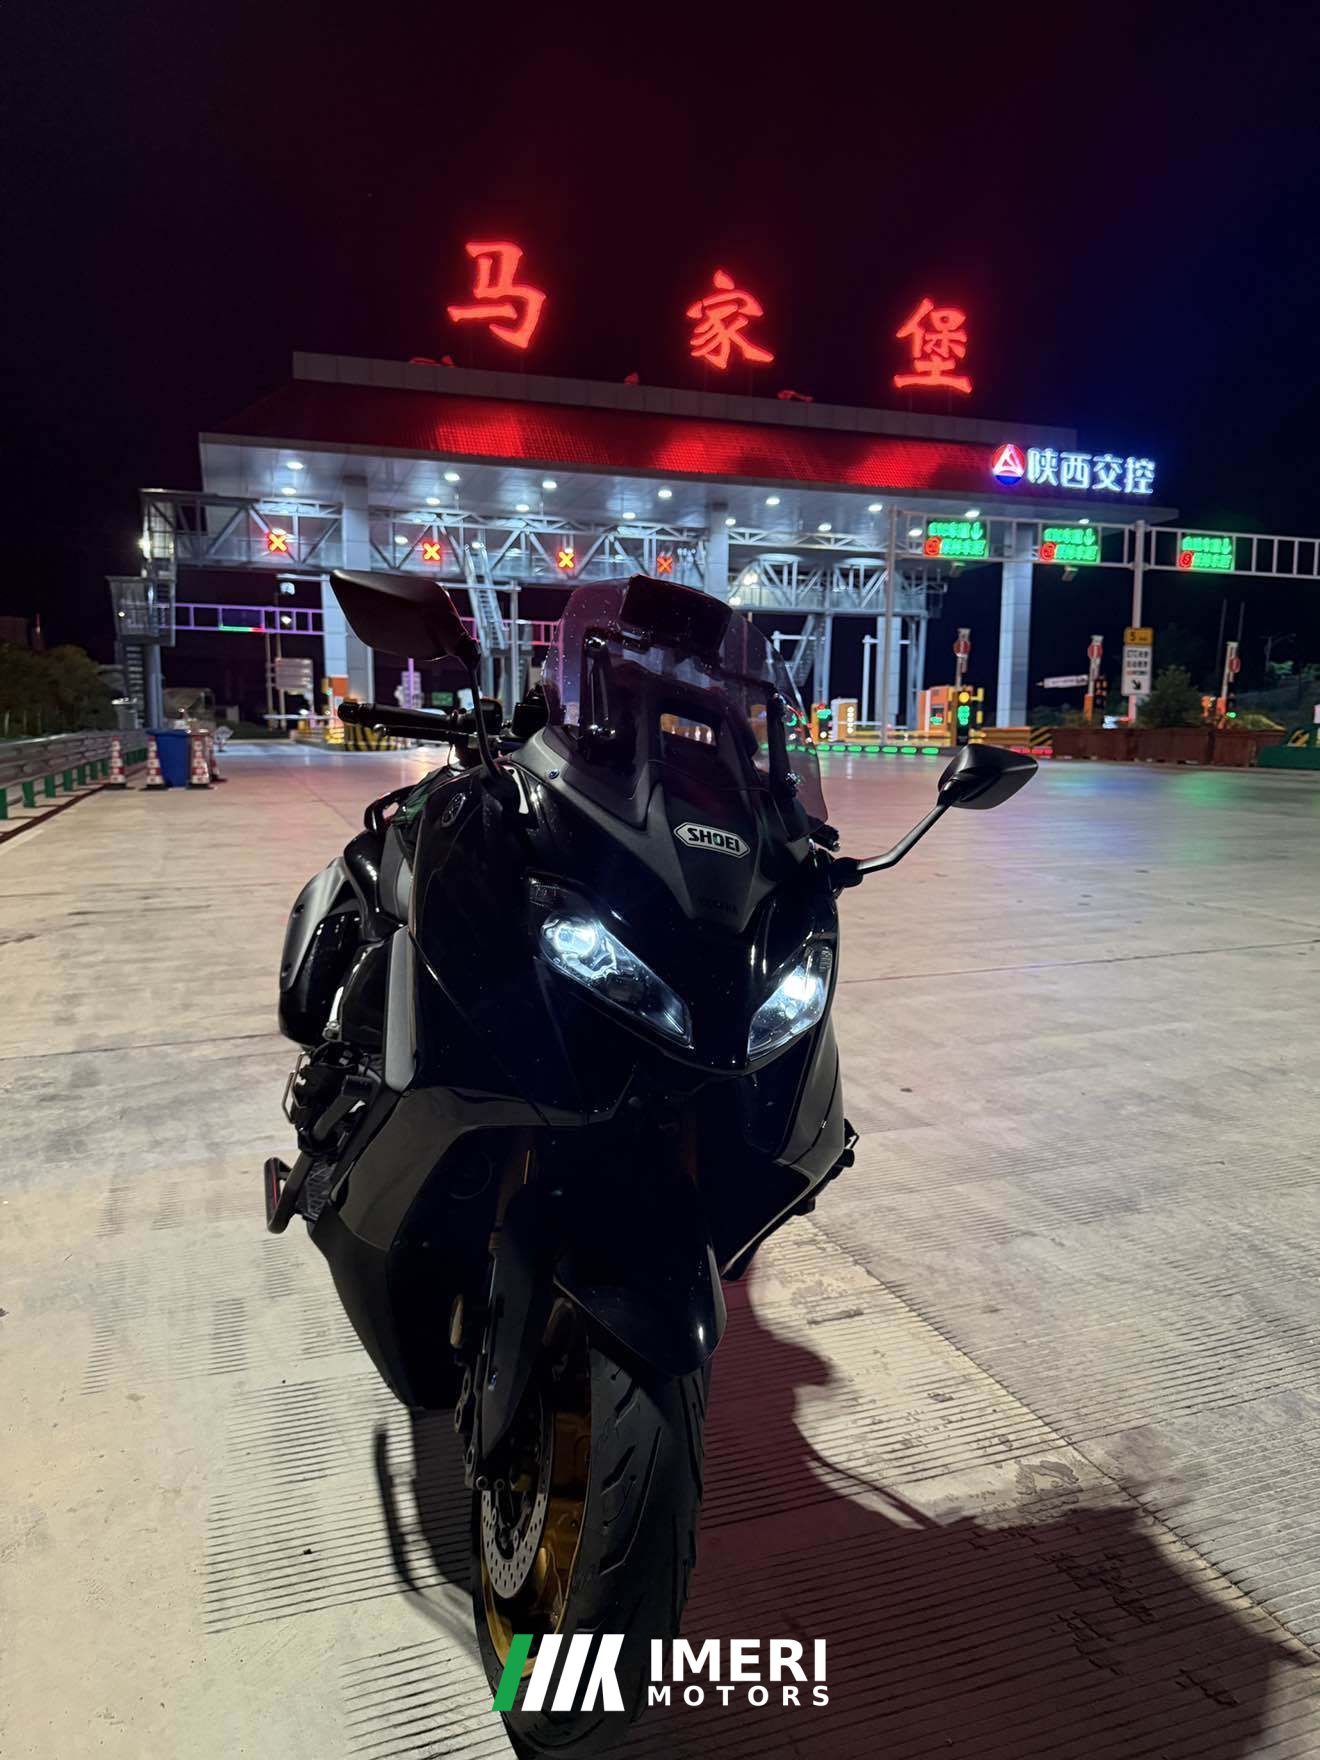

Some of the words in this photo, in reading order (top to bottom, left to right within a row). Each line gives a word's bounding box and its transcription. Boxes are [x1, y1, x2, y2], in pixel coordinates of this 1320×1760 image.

[448, 240, 972, 394] 马家堡
[1027, 447, 1156, 494] 陕西交控
[687, 827, 741, 852] SHOEI
